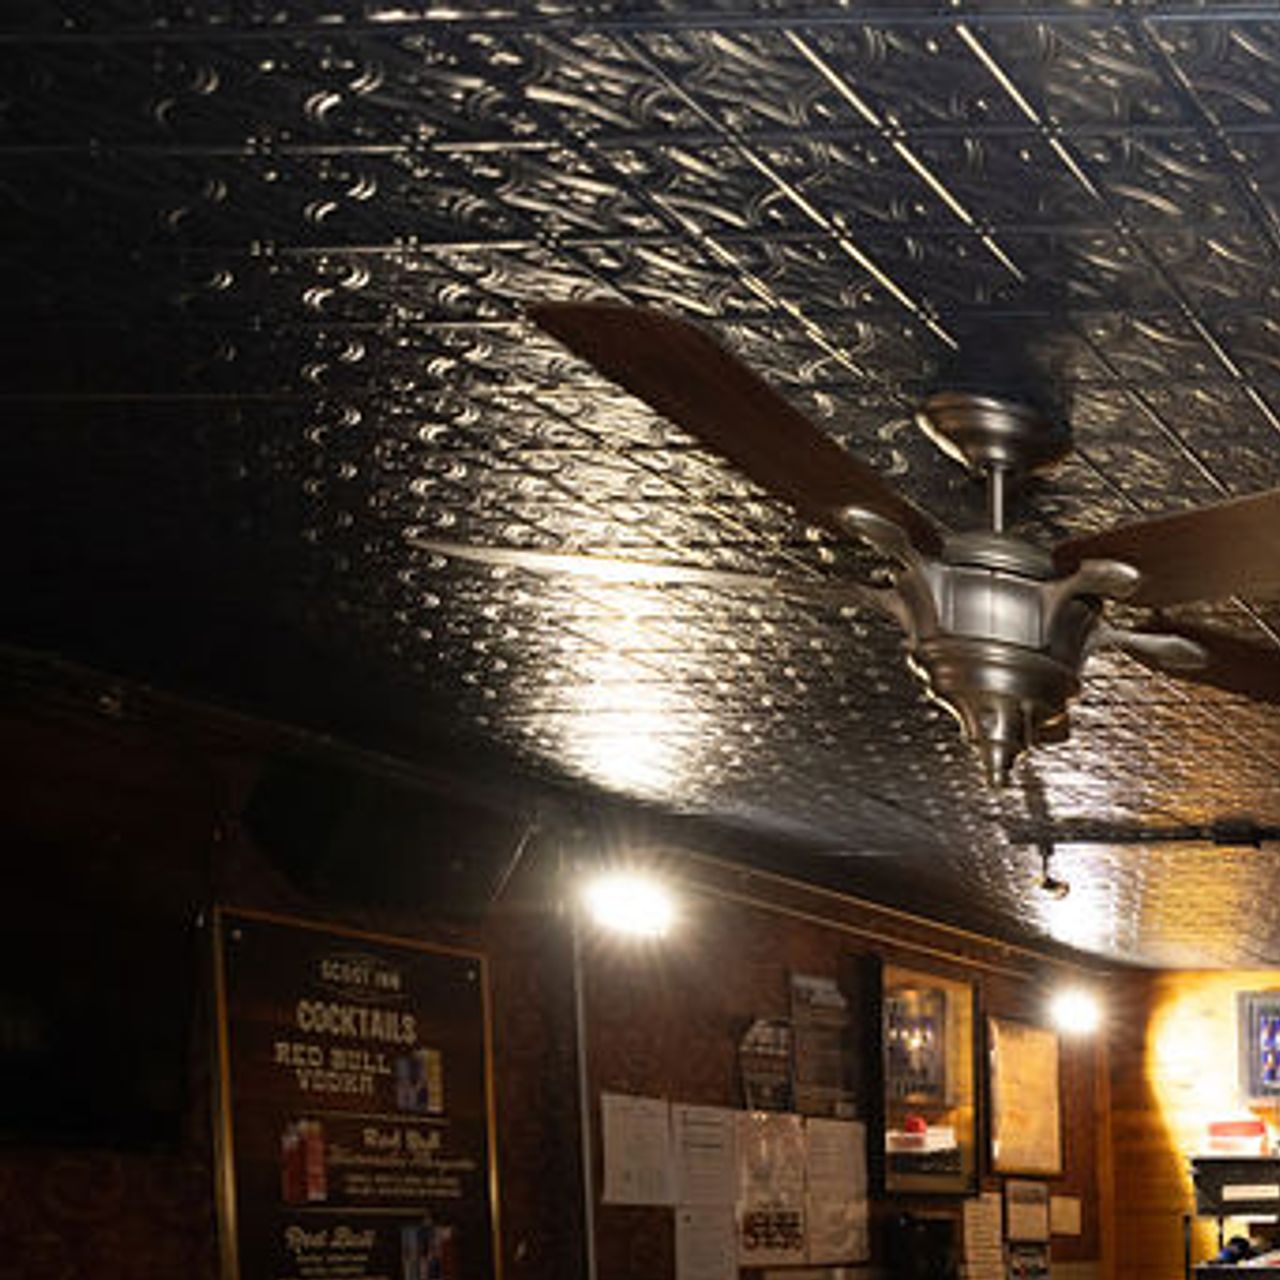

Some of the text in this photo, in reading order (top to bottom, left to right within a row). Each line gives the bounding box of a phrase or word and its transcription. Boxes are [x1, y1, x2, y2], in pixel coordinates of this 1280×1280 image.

[296, 999, 418, 1046] COCKTAILS
[273, 1041, 392, 1075] RED BULL
[295, 1068, 374, 1096] VODKA
